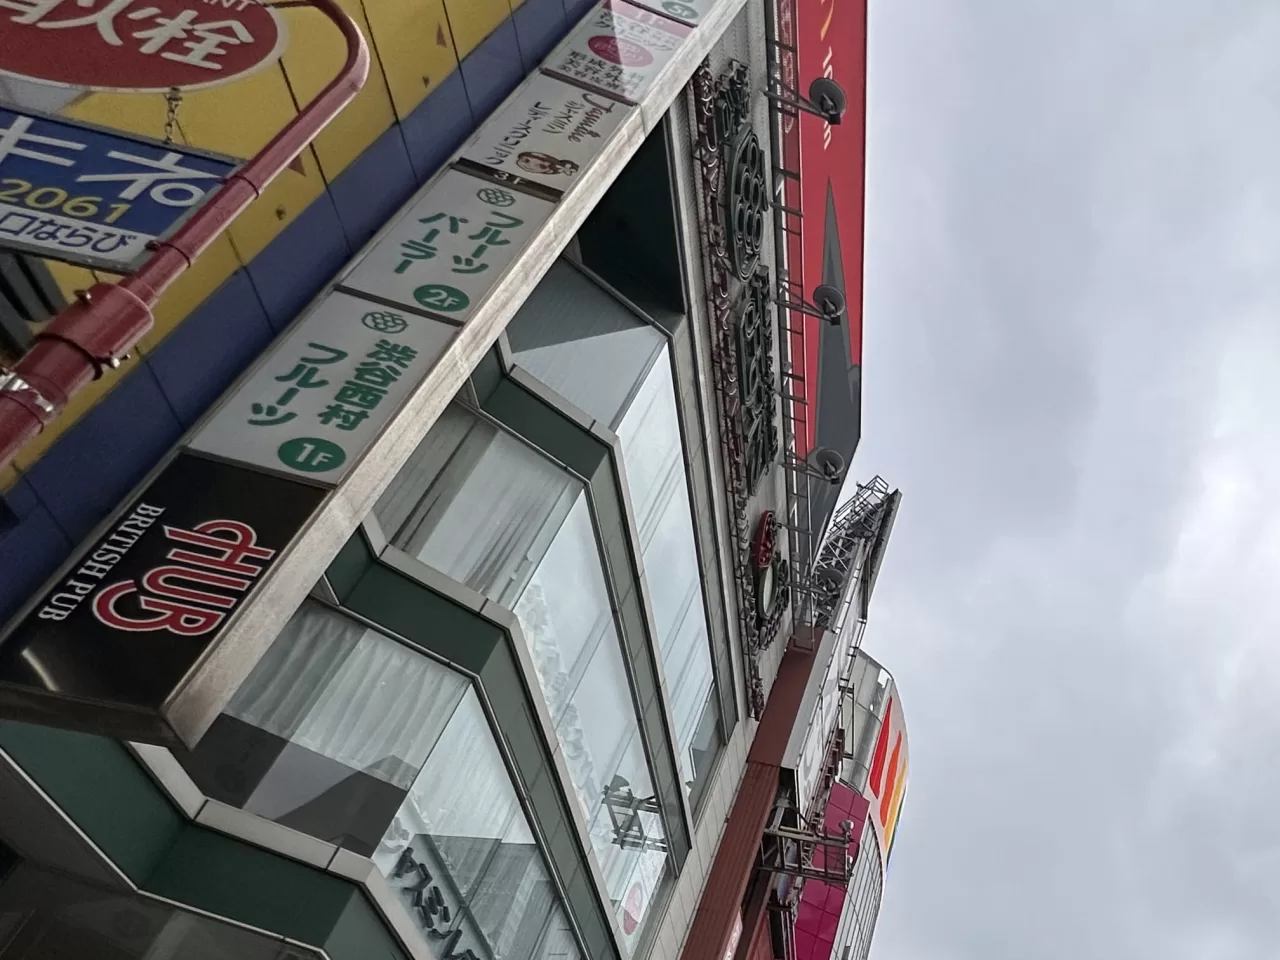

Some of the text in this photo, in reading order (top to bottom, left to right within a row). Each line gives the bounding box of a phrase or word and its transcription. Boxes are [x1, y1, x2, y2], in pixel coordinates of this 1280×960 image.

[494, 171, 527, 185] 3F
[394, 212, 469, 274] パーラー
[451, 211, 524, 274] フルーツ
[423, 289, 461, 308] 2F
[248, 342, 348, 426] フルーツ
[317, 339, 419, 431] 渋谷西村
[296, 443, 334, 466] 1F
[38, 503, 166, 621] BRITISH PUB
[92, 519, 276, 636] HUB
